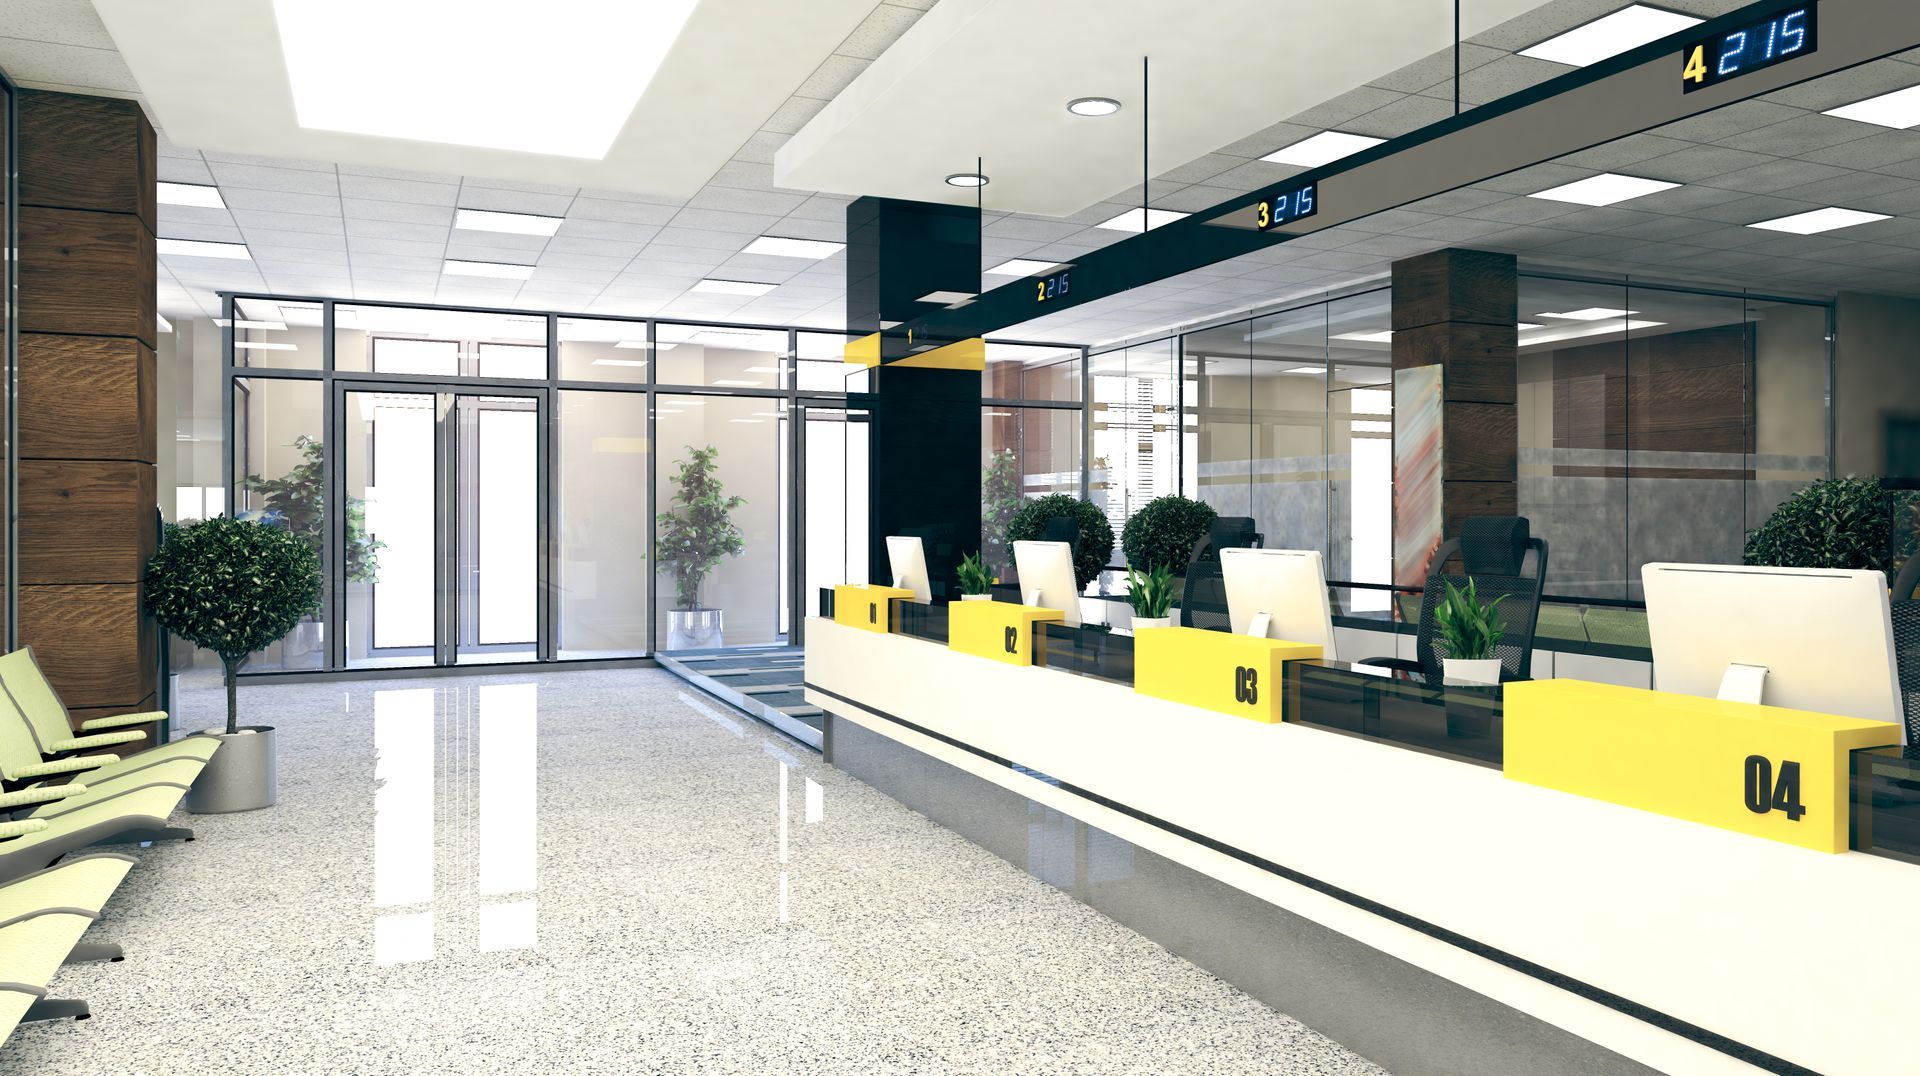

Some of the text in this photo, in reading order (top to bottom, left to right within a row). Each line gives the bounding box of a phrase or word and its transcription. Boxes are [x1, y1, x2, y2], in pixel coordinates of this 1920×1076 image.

[1683, 9, 1805, 83] 4 215
[1257, 185, 1313, 228] 3 215
[1037, 273, 1069, 302] 2 215
[1005, 625, 1018, 655] 02
[1235, 665, 1258, 706] 03
[1744, 754, 1806, 822] 04
